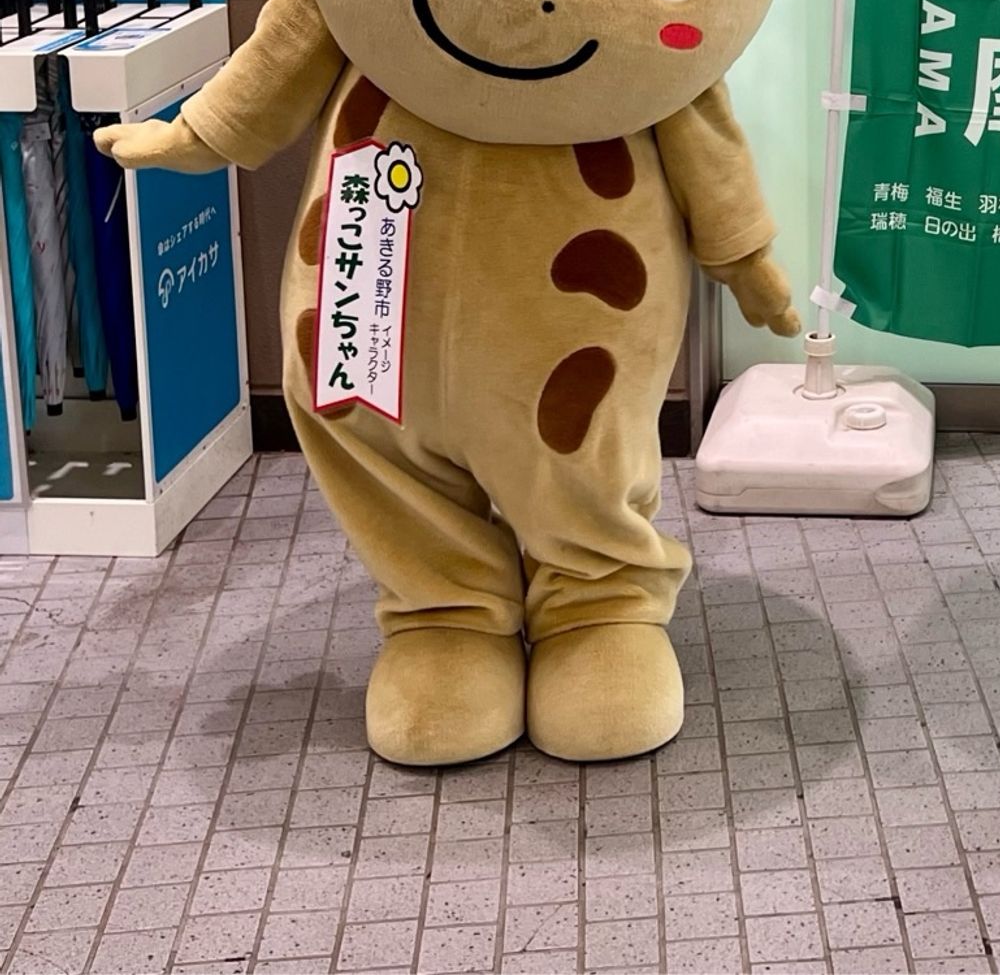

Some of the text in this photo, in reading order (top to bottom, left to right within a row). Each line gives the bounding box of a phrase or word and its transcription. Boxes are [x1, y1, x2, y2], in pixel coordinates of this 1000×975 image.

[873, 182, 910, 202] 青梅
[925, 186, 962, 211] 福生
[869, 211, 907, 231] 瑞穂
[924, 215, 977, 243] 日の出
[177, 241, 220, 294] アイカサ
[328, 173, 371, 391] 森っこサンちゃん
[374, 217, 397, 318] あきる野市
[366, 324, 380, 395] キャラクター
[380, 324, 393, 372] イメージ
